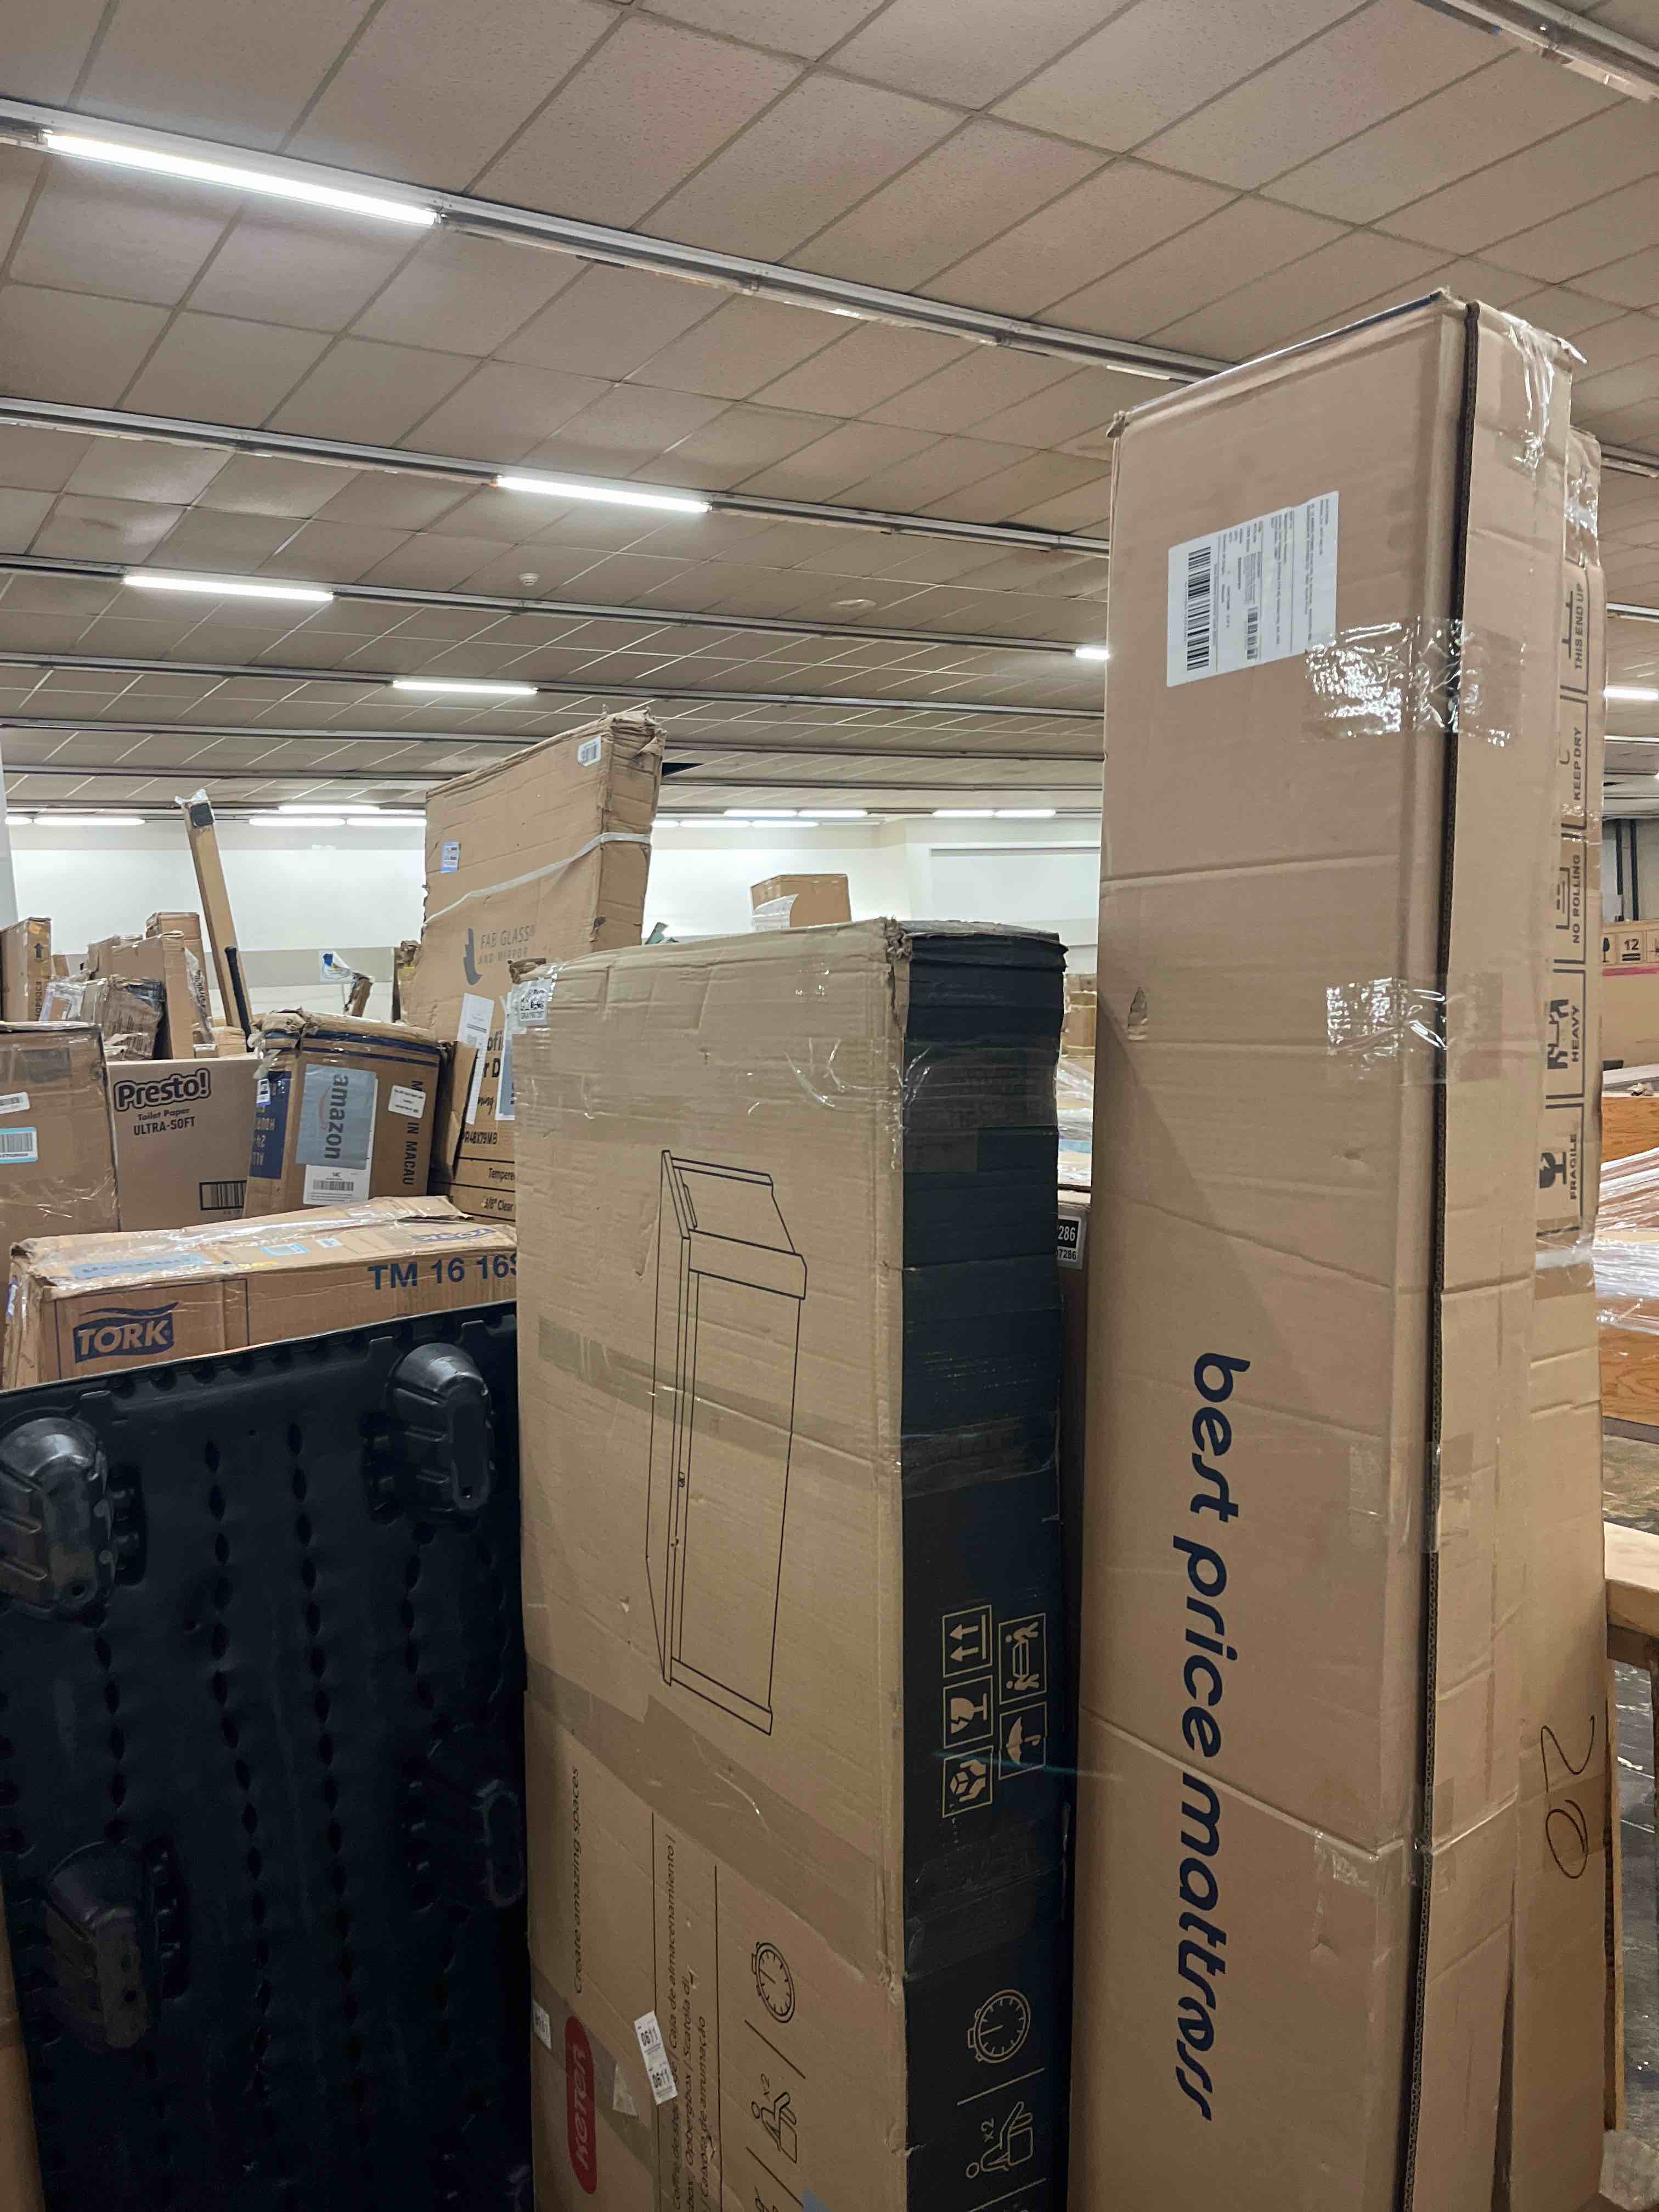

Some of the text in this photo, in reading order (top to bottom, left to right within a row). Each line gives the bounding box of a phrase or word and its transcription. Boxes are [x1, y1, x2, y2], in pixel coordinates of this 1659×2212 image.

[1573, 583, 1584, 670] THIS END UP
[1573, 727, 1582, 802] KEEP DRY
[1572, 854, 1581, 944] NO ROLLING
[1623, 939, 1639, 951] 12
[1571, 1005, 1580, 1063] HEAVY
[116, 1070, 209, 1110] Presto!
[137, 1108, 191, 1121] Toilet Paper
[134, 1116, 196, 1136] ULTRA-SOFT
[324, 1074, 349, 1160] amazon
[402, 1122, 420, 1186] IN MACAU
[1057, 1225, 1076, 1242] 286
[1057, 1249, 1076, 1260] 7286
[368, 1263, 417, 1290] TM
[431, 1257, 465, 1284] 16
[78, 1319, 168, 1356] TORK
[1192, 1351, 1251, 1523] best
[1172, 1535, 1238, 1758] price
[571, 1766, 583, 1993] Create amazing spaces
[980, 2118, 995, 2142] x2
